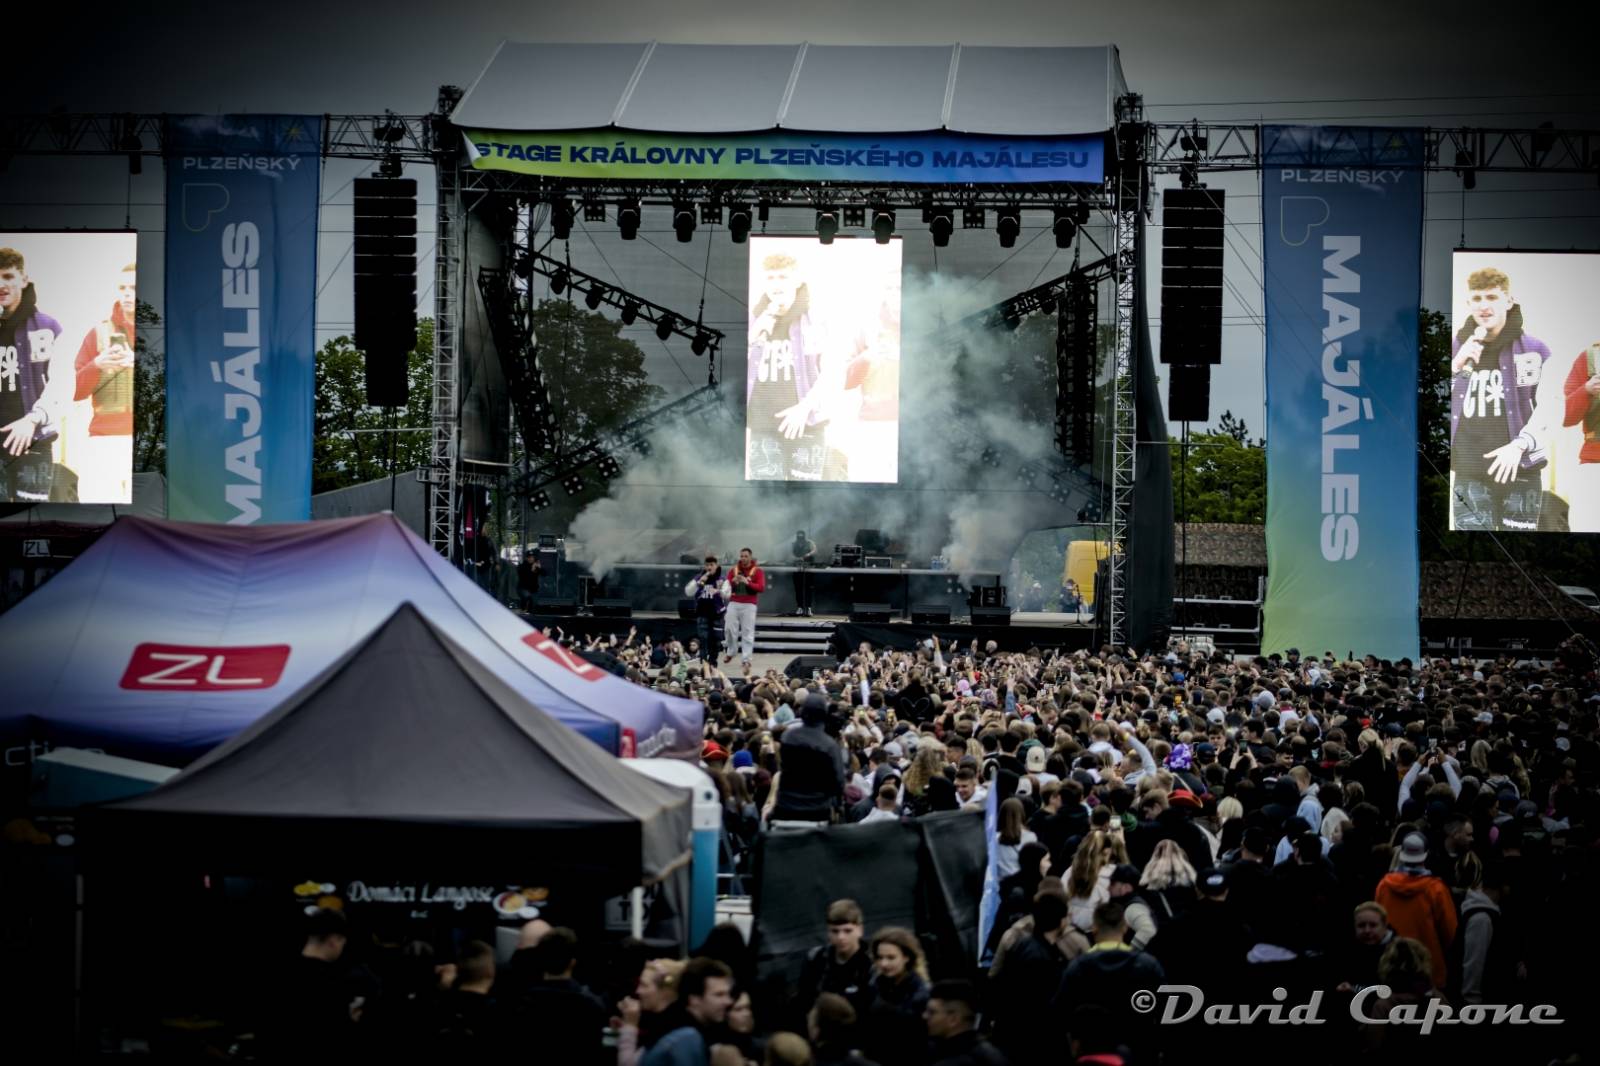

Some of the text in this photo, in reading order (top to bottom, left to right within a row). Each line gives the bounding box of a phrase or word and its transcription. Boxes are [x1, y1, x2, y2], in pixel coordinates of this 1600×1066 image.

[183, 153, 301, 170] PLZEŇSKÝ
[475, 141, 1089, 169] STAGE KRÁLOVNY PLZEŇSKÉHO MAJÁLESU
[210, 220, 263, 526] MAJÁLES
[1320, 235, 1374, 562] MAJÁLES
[137, 652, 263, 685] ZL
